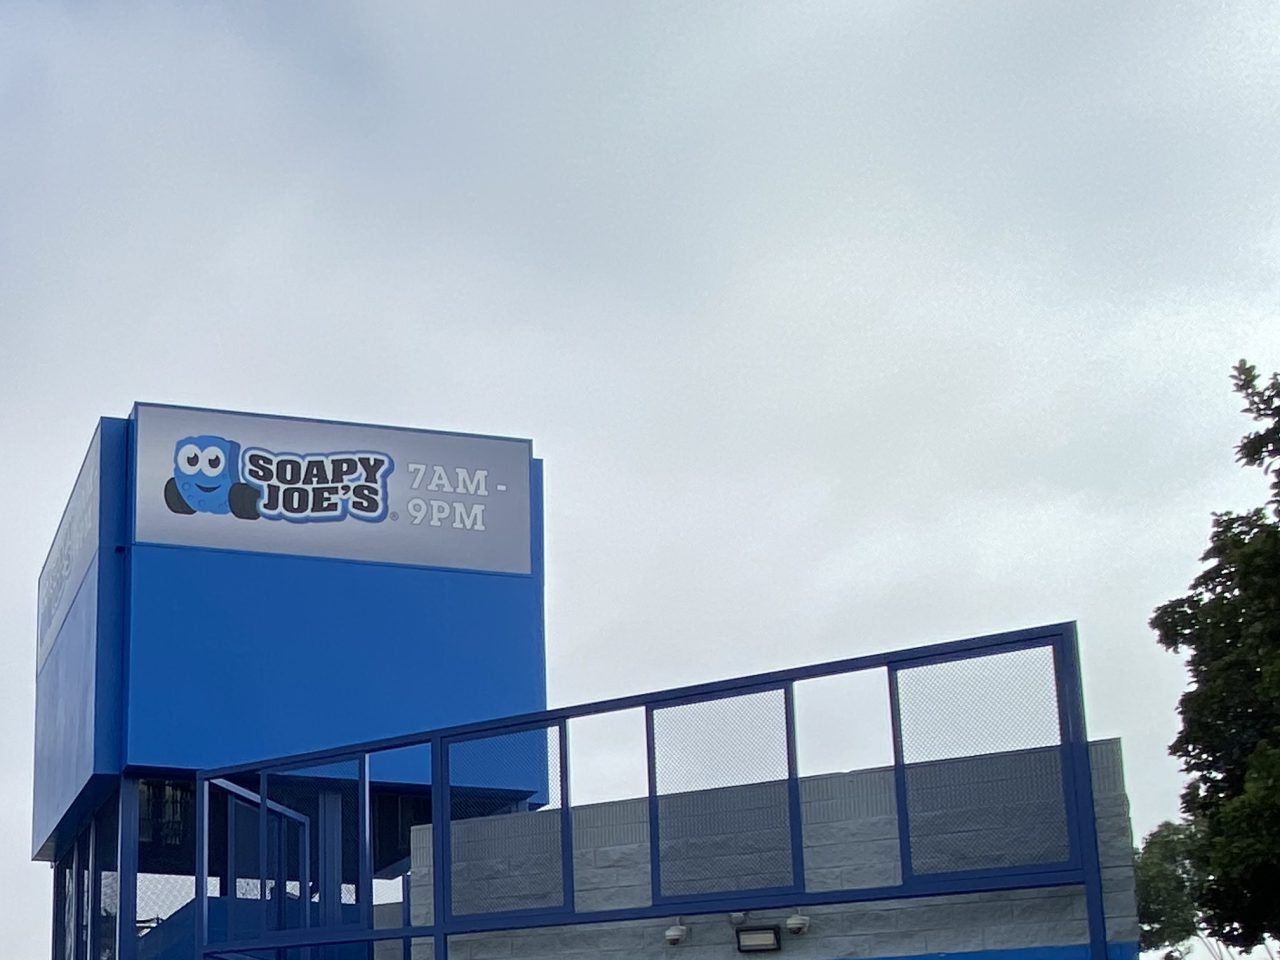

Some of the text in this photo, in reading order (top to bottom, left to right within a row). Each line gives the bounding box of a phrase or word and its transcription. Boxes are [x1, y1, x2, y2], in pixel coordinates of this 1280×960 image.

[247, 453, 386, 486] SOAPY
[406, 463, 489, 497] 7AM
[262, 485, 380, 515] JOE'S
[406, 498, 486, 532] 9PM
